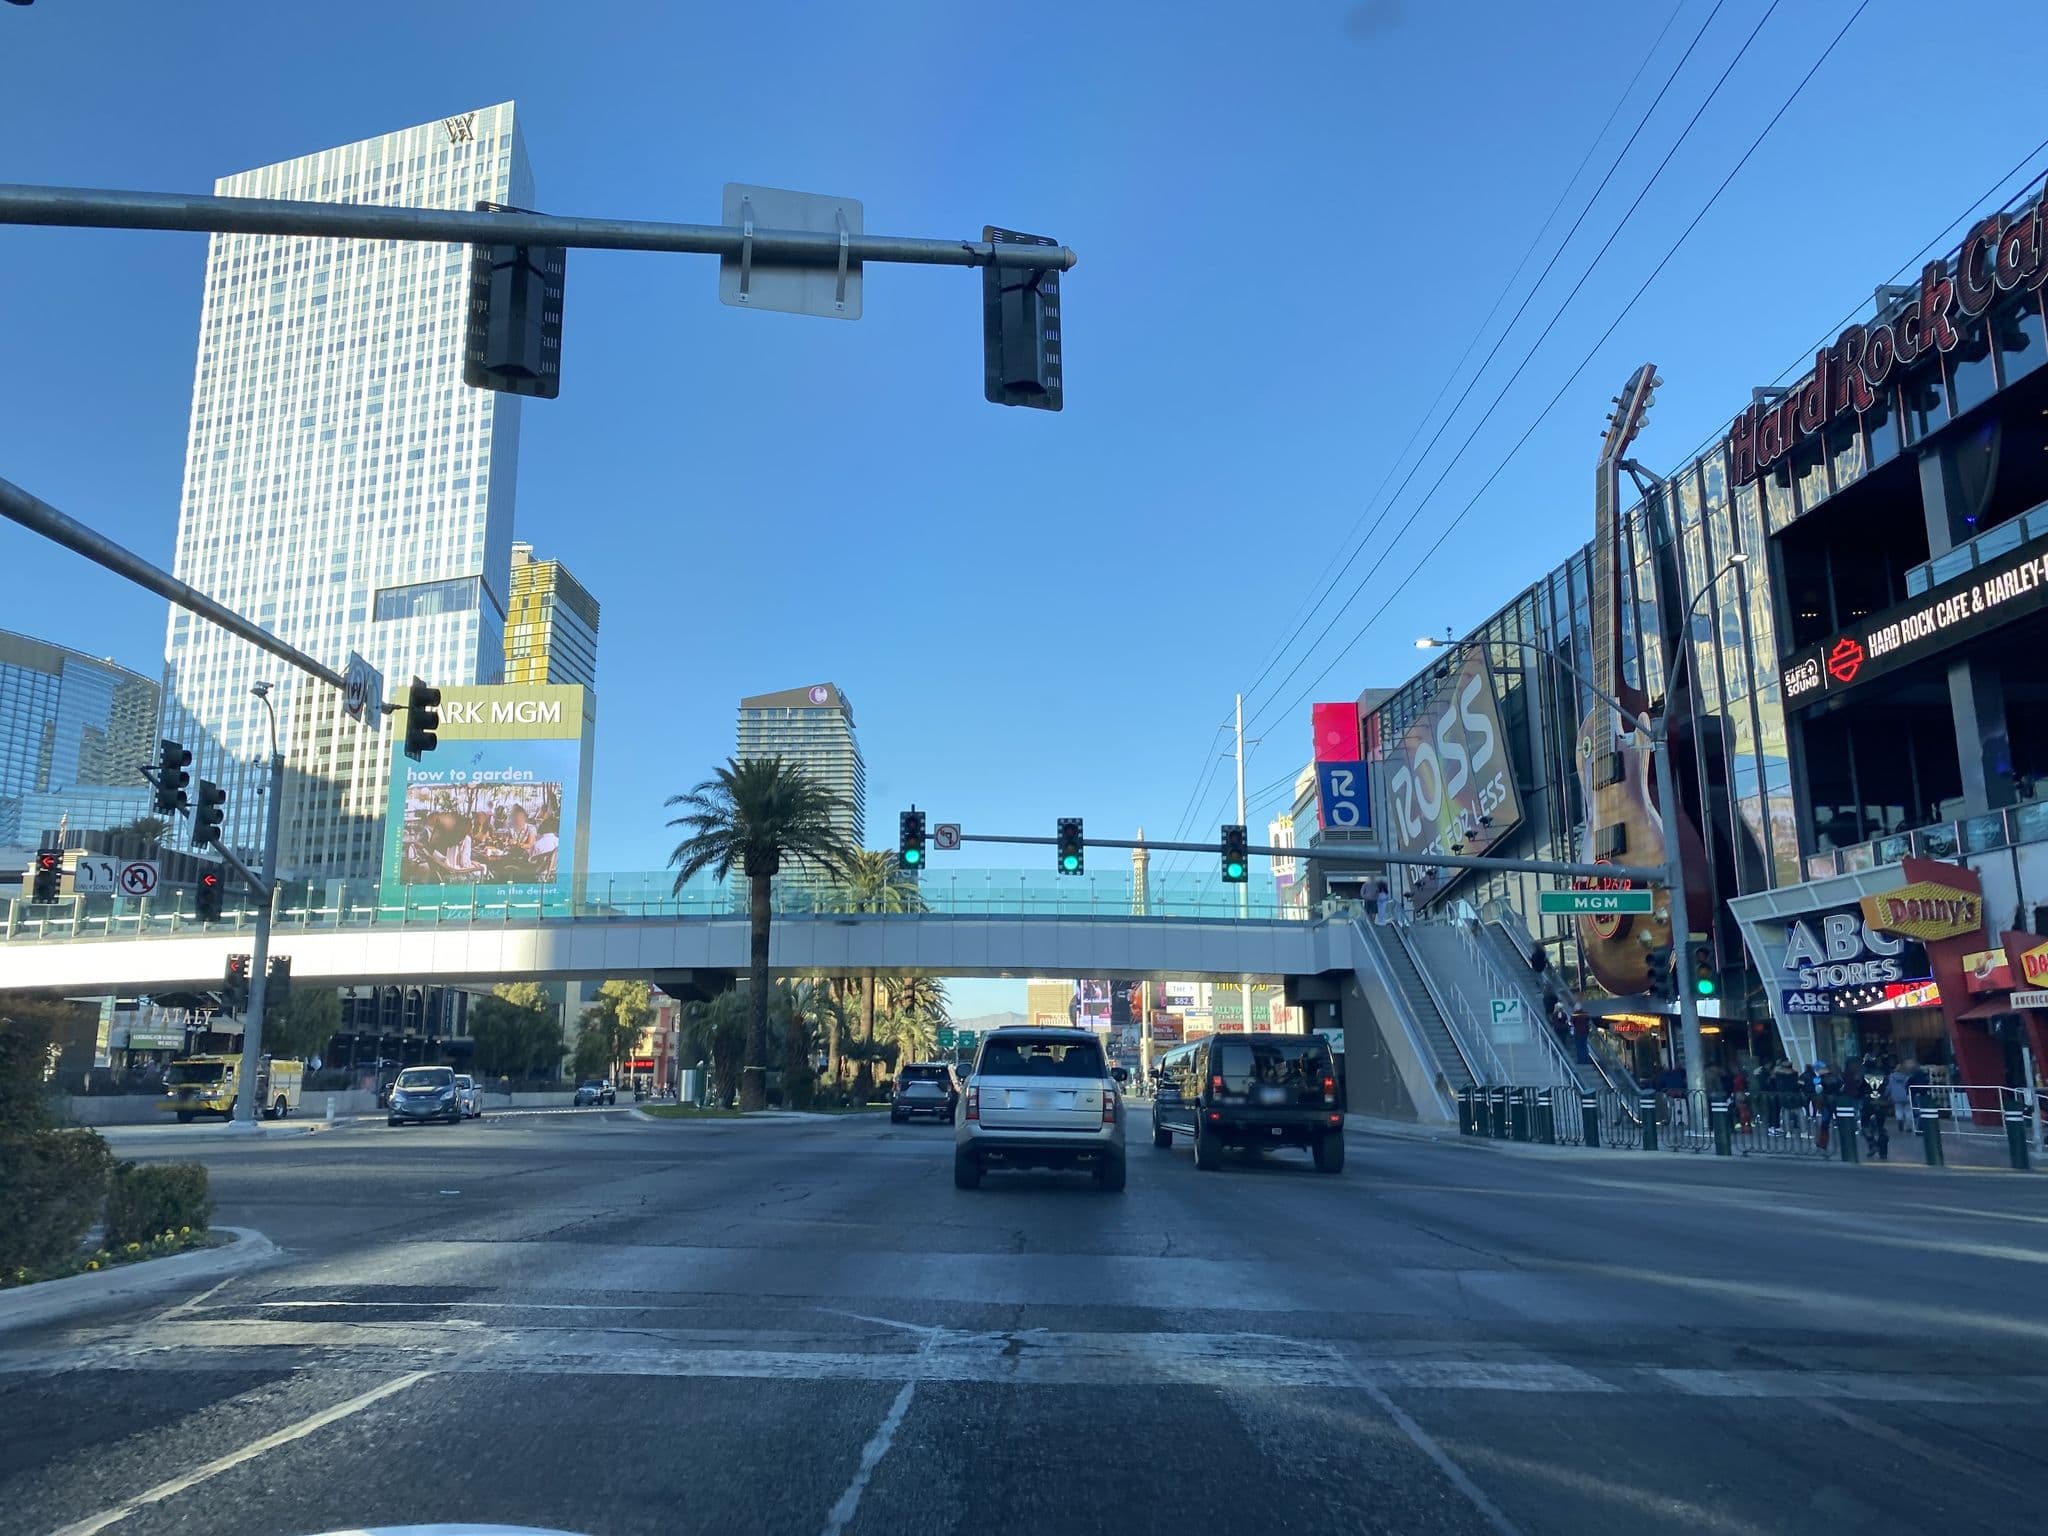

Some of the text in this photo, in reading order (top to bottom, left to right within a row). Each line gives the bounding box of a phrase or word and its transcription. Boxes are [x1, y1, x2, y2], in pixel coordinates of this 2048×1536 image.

[1730, 346, 1836, 487] Hard
[1832, 256, 1959, 412] Rock
[1867, 623, 1901, 659] HARD
[1901, 606, 1937, 645] ROCK
[1936, 591, 1970, 628] CAFE
[1971, 586, 1985, 613] &
[1787, 675, 1819, 697] SOUND
[425, 700, 562, 724] ARK MGM
[1391, 674, 1494, 847] ROSS
[407, 766, 533, 785] how to garden
[1470, 771, 1507, 826] LESS
[497, 886, 560, 896] in the deert.
[1574, 897, 1618, 908] MGM
[1887, 896, 1976, 927] Denny's
[1783, 914, 1901, 969] ABC
[1799, 959, 1899, 989] STORES
[1788, 992, 1830, 1005] ABC
[1789, 1004, 1830, 1012] STORES
